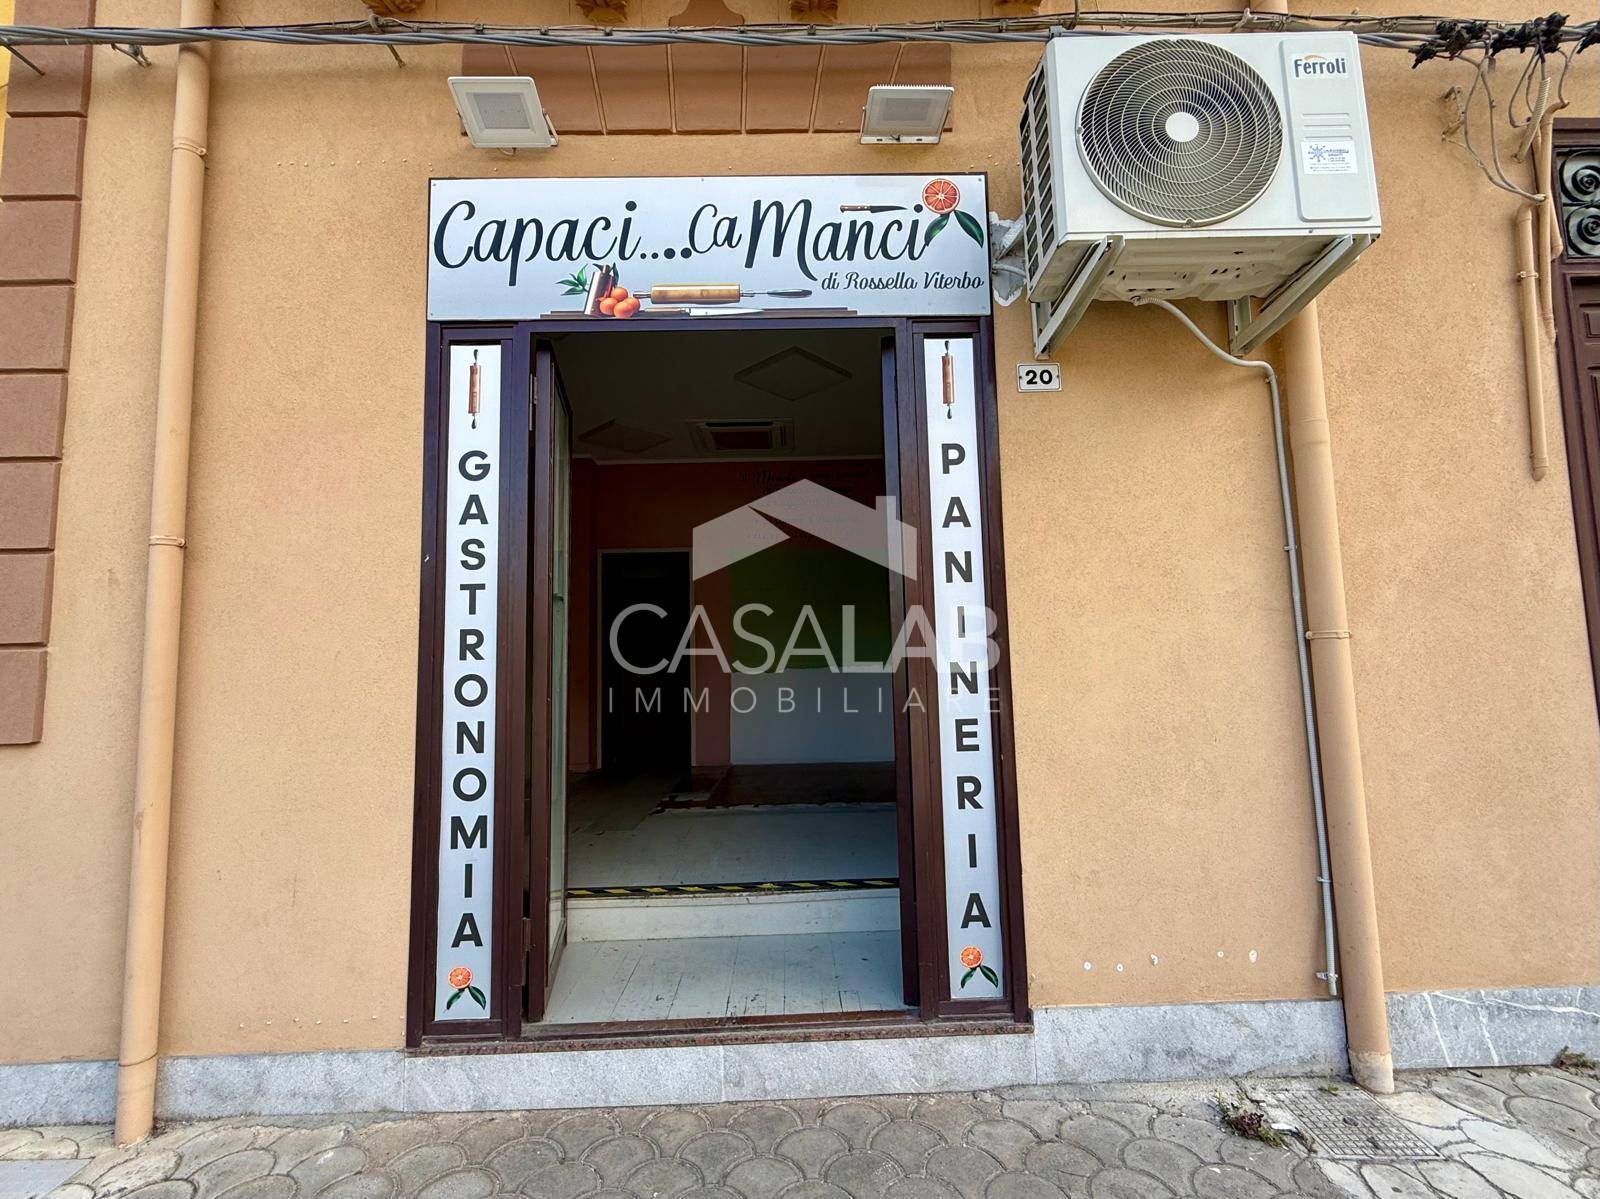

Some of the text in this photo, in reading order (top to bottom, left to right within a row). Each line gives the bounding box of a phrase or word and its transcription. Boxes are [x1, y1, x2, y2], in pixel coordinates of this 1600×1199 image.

[1294, 58, 1347, 78] Ferroli
[744, 198, 932, 281] Manci
[821, 271, 985, 290] di Rossella Viterbo
[1025, 369, 1053, 385] 20
[449, 449, 491, 949] GASTRONOMIA
[941, 442, 993, 929] PANINERIA
